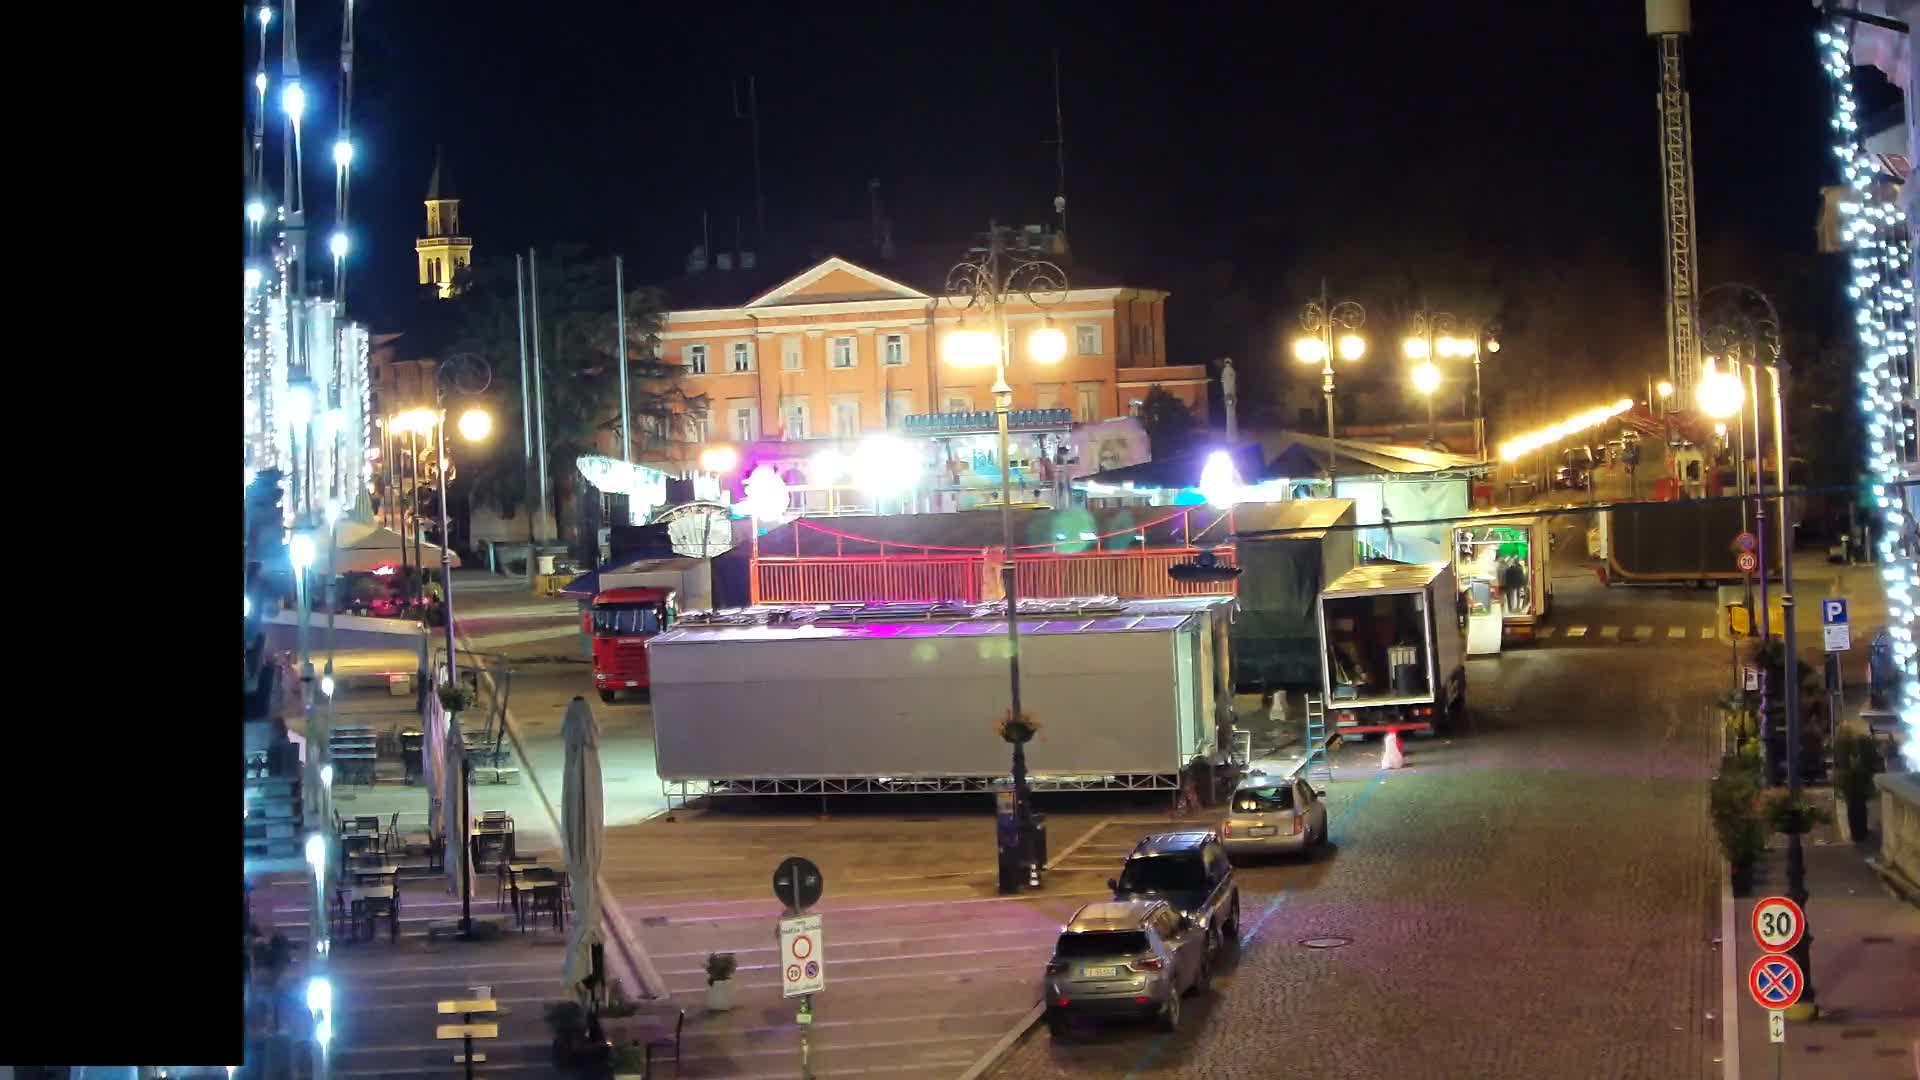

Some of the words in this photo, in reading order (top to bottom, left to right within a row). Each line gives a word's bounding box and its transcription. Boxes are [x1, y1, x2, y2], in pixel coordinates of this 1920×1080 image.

[1742, 558, 1753, 567] 20
[1827, 602, 1842, 622] P
[1762, 911, 1792, 937] 30
